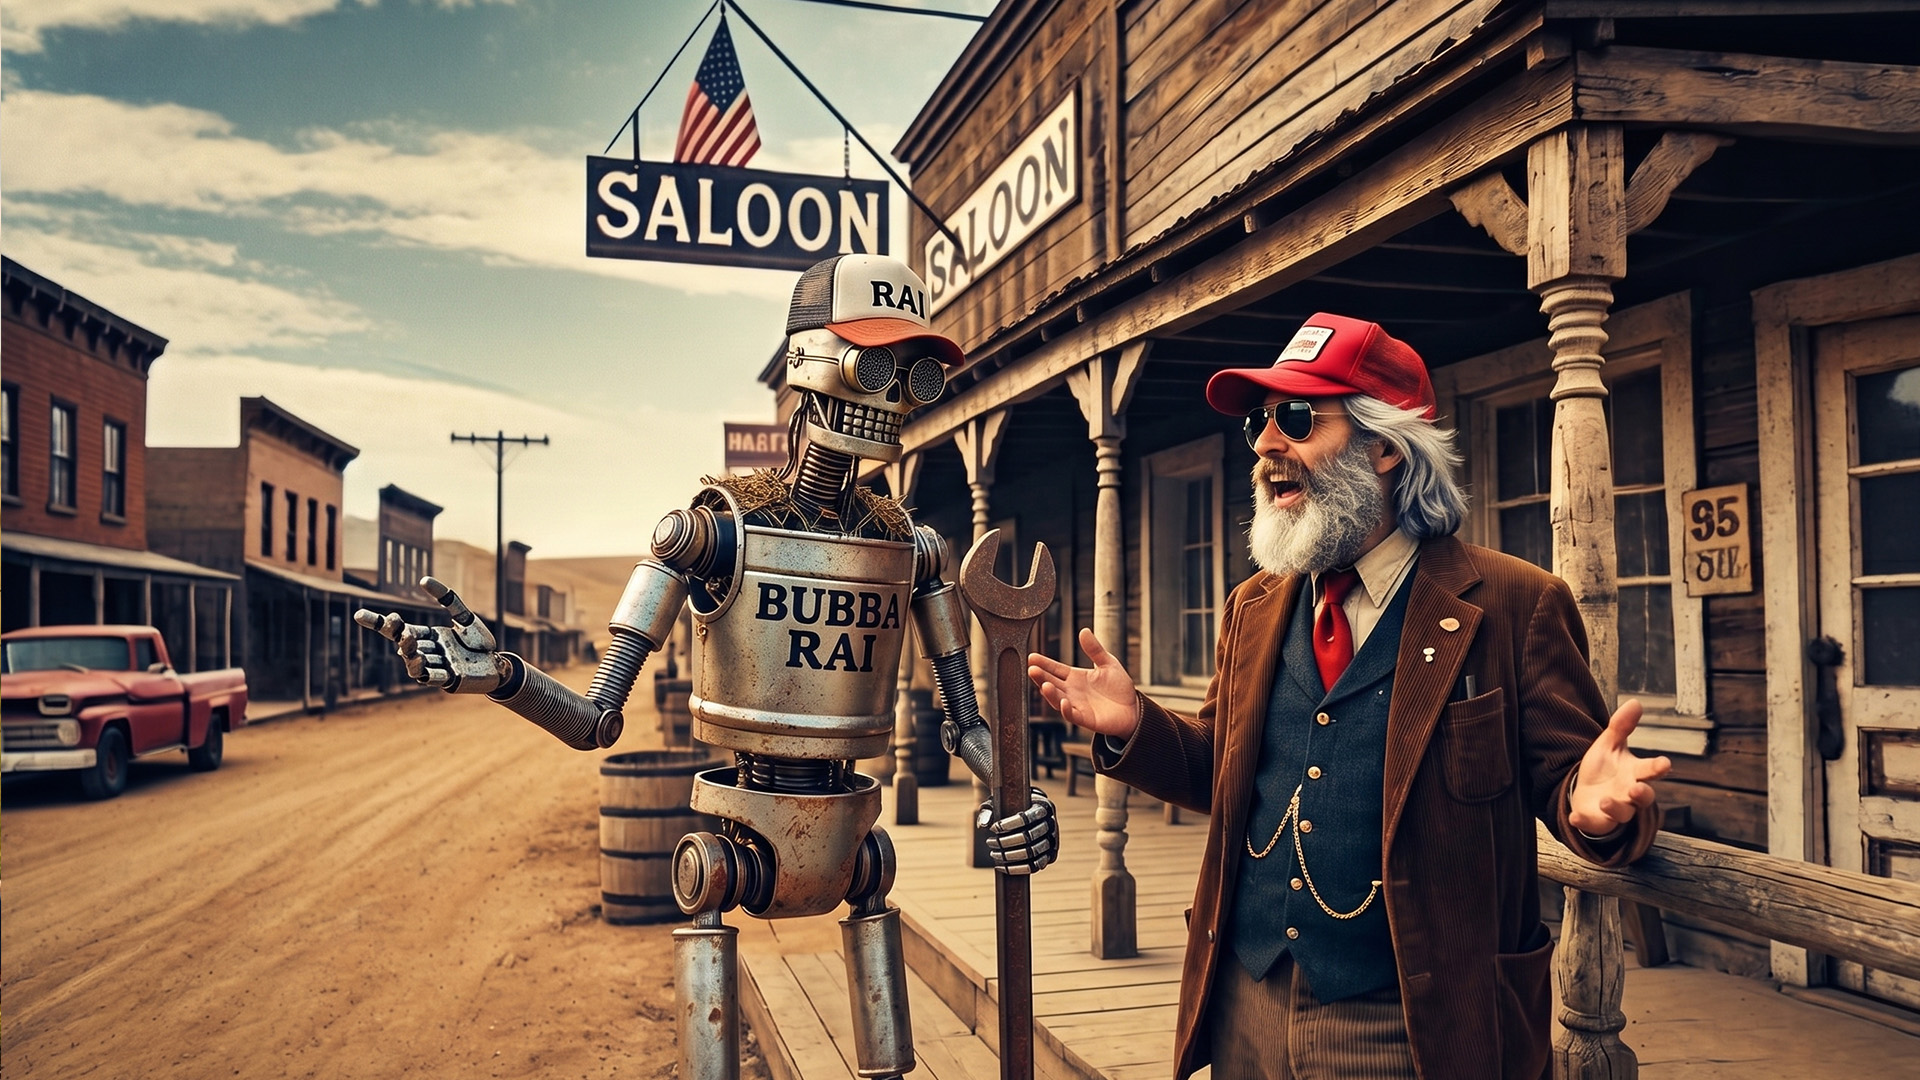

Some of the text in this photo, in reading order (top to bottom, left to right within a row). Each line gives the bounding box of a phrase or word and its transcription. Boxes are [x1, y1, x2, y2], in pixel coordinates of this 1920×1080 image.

[597, 171, 879, 254] SALOON
[930, 117, 1068, 303] SALOON
[870, 280, 925, 320] RAI
[1691, 496, 1739, 542] 95
[755, 582, 899, 629] BUBBA
[786, 629, 877, 672] RAI
